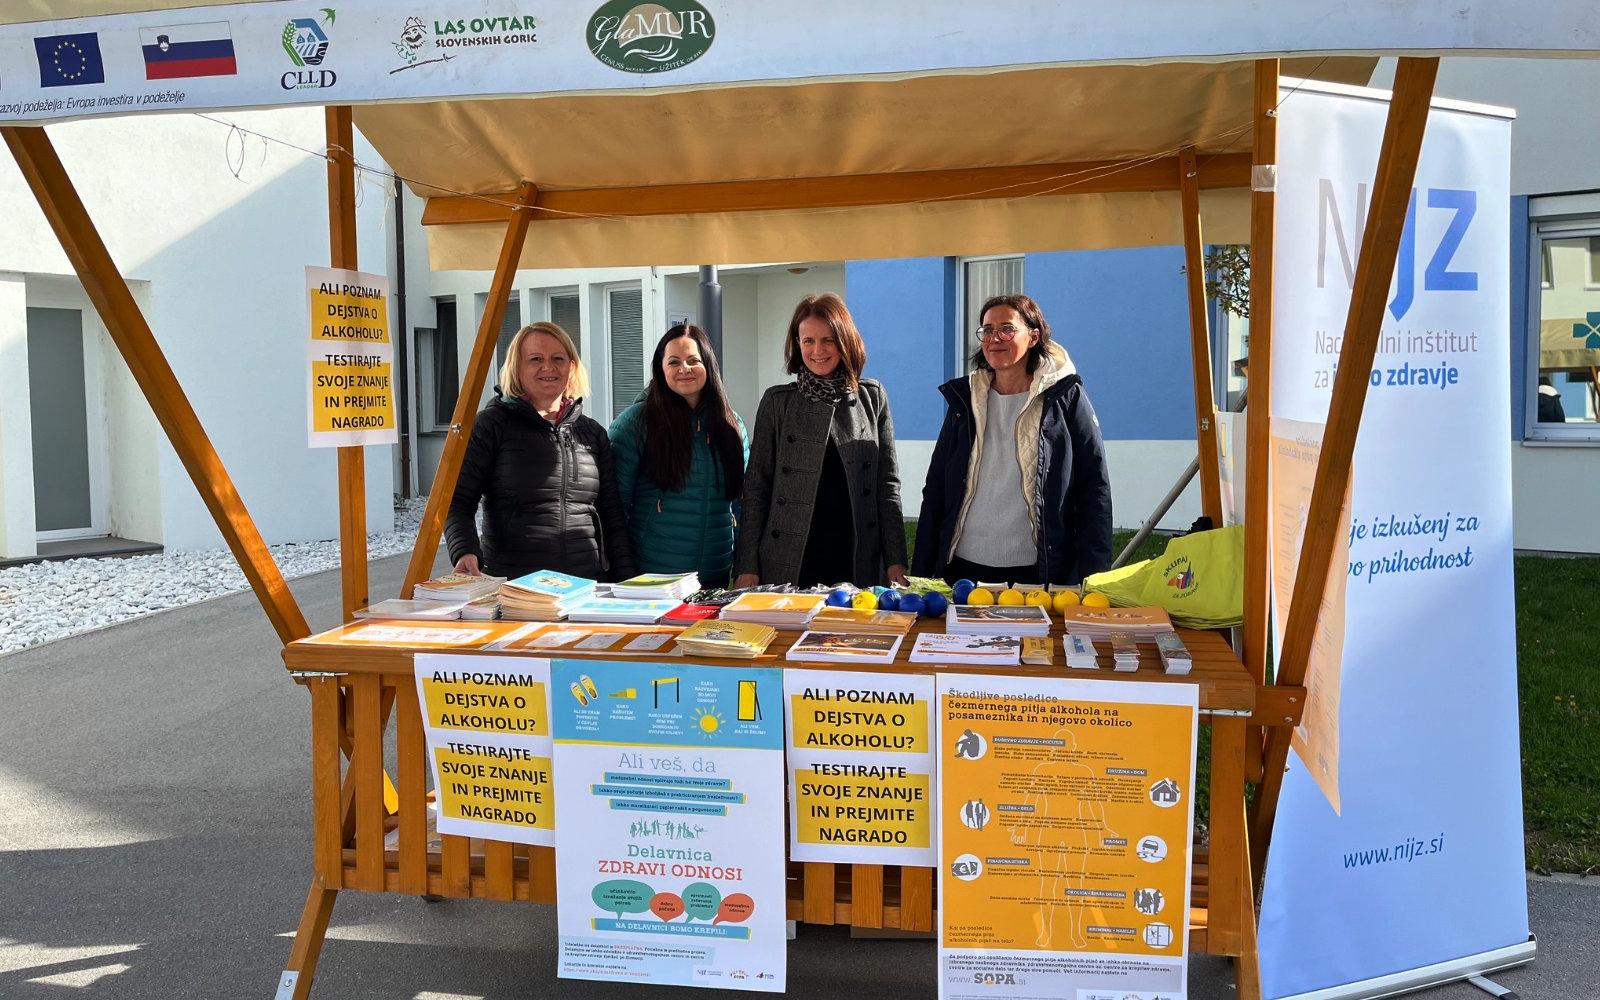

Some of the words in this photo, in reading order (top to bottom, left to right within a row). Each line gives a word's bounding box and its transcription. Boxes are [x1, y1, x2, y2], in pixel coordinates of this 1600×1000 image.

[434, 18, 465, 36] LAS
[469, 15, 537, 34] OVTAR
[435, 36, 502, 48] SLOVENSKIH
[503, 34, 538, 46] GORIC
[600, 53, 625, 71] GENUSS
[659, 60, 686, 71] UŽITEK
[280, 69, 337, 91] CLLD
[23, 99, 65, 114] podeželja:
[66, 97, 96, 112] Evropa
[97, 94, 134, 107] investira
[136, 96, 142, 105] v
[142, 90, 186, 106] podeželje
[319, 282, 339, 296] ALI
[343, 284, 381, 300] POZNAM
[327, 304, 370, 319] DEJSTVA
[371, 308, 378, 320] O
[321, 325, 383, 340] ALKOHOLU?
[1315, 329, 1401, 354] Naclni
[1408, 330, 1478, 353] inštitut
[325, 354, 381, 370] TESTIRAJTE
[317, 375, 355, 390] SVOJE
[357, 375, 389, 390] ZNANJE
[1314, 369, 1329, 389] za
[1387, 361, 1459, 391] zdravje
[324, 396, 340, 408] IN
[344, 395, 387, 410] PREJMITE
[331, 415, 384, 429] NAGRADO
[1372, 511, 1451, 542] izkušenj
[1456, 516, 1481, 532] za
[1164, 555, 1188, 578] SKUPAJ
[1368, 546, 1475, 584] prihodnost
[432, 671, 457, 684] ALI
[462, 672, 534, 687] POZNAM
[445, 693, 510, 708] DEJSTVA
[514, 696, 526, 709] O
[803, 688, 830, 701] ALI
[836, 689, 915, 705] POZNAM
[948, 687, 1000, 701] Škodljive
[1003, 694, 1058, 704] posledice
[948, 700, 1018, 714] čezmernega
[1021, 703, 1047, 715] pitja
[1050, 705, 1100, 716] alkohola
[1104, 709, 1119, 717] na
[440, 713, 536, 731] ALKOHOLU?
[814, 710, 887, 727] DEJSTVA
[892, 714, 905, 727] O
[948, 711, 1023, 723] posameznika
[1027, 713, 1039, 722] in
[1042, 714, 1087, 726] njegovo
[1089, 717, 1133, 728] okolico
[806, 732, 915, 749] ALKOHOLU?
[447, 742, 531, 763] TESTIRAJTE
[618, 753, 644, 770] Ali
[650, 756, 686, 774] veš,
[692, 757, 716, 773] da
[811, 763, 907, 781] TESTIRAJTE
[441, 761, 485, 778] SVOJE
[489, 766, 548, 785] ZNANJE
[452, 783, 468, 796] IN
[473, 785, 542, 804] PREJMITE
[801, 784, 851, 800] SVOJE
[856, 786, 923, 803] ZNANJE
[461, 804, 537, 825] NAGRADO
[811, 805, 830, 818] IN
[835, 806, 915, 822] PREJMITE
[819, 827, 908, 844] NAGRADO
[627, 844, 713, 862] Delavnica
[1343, 832, 1444, 869] www.nijz.si
[598, 860, 665, 876] ZDRAVI
[671, 864, 743, 881] ODNOSI
[628, 923, 668, 931] DELAVNICI
[670, 925, 693, 933] BOMO
[949, 972, 1026, 986] www.SOPA.si
